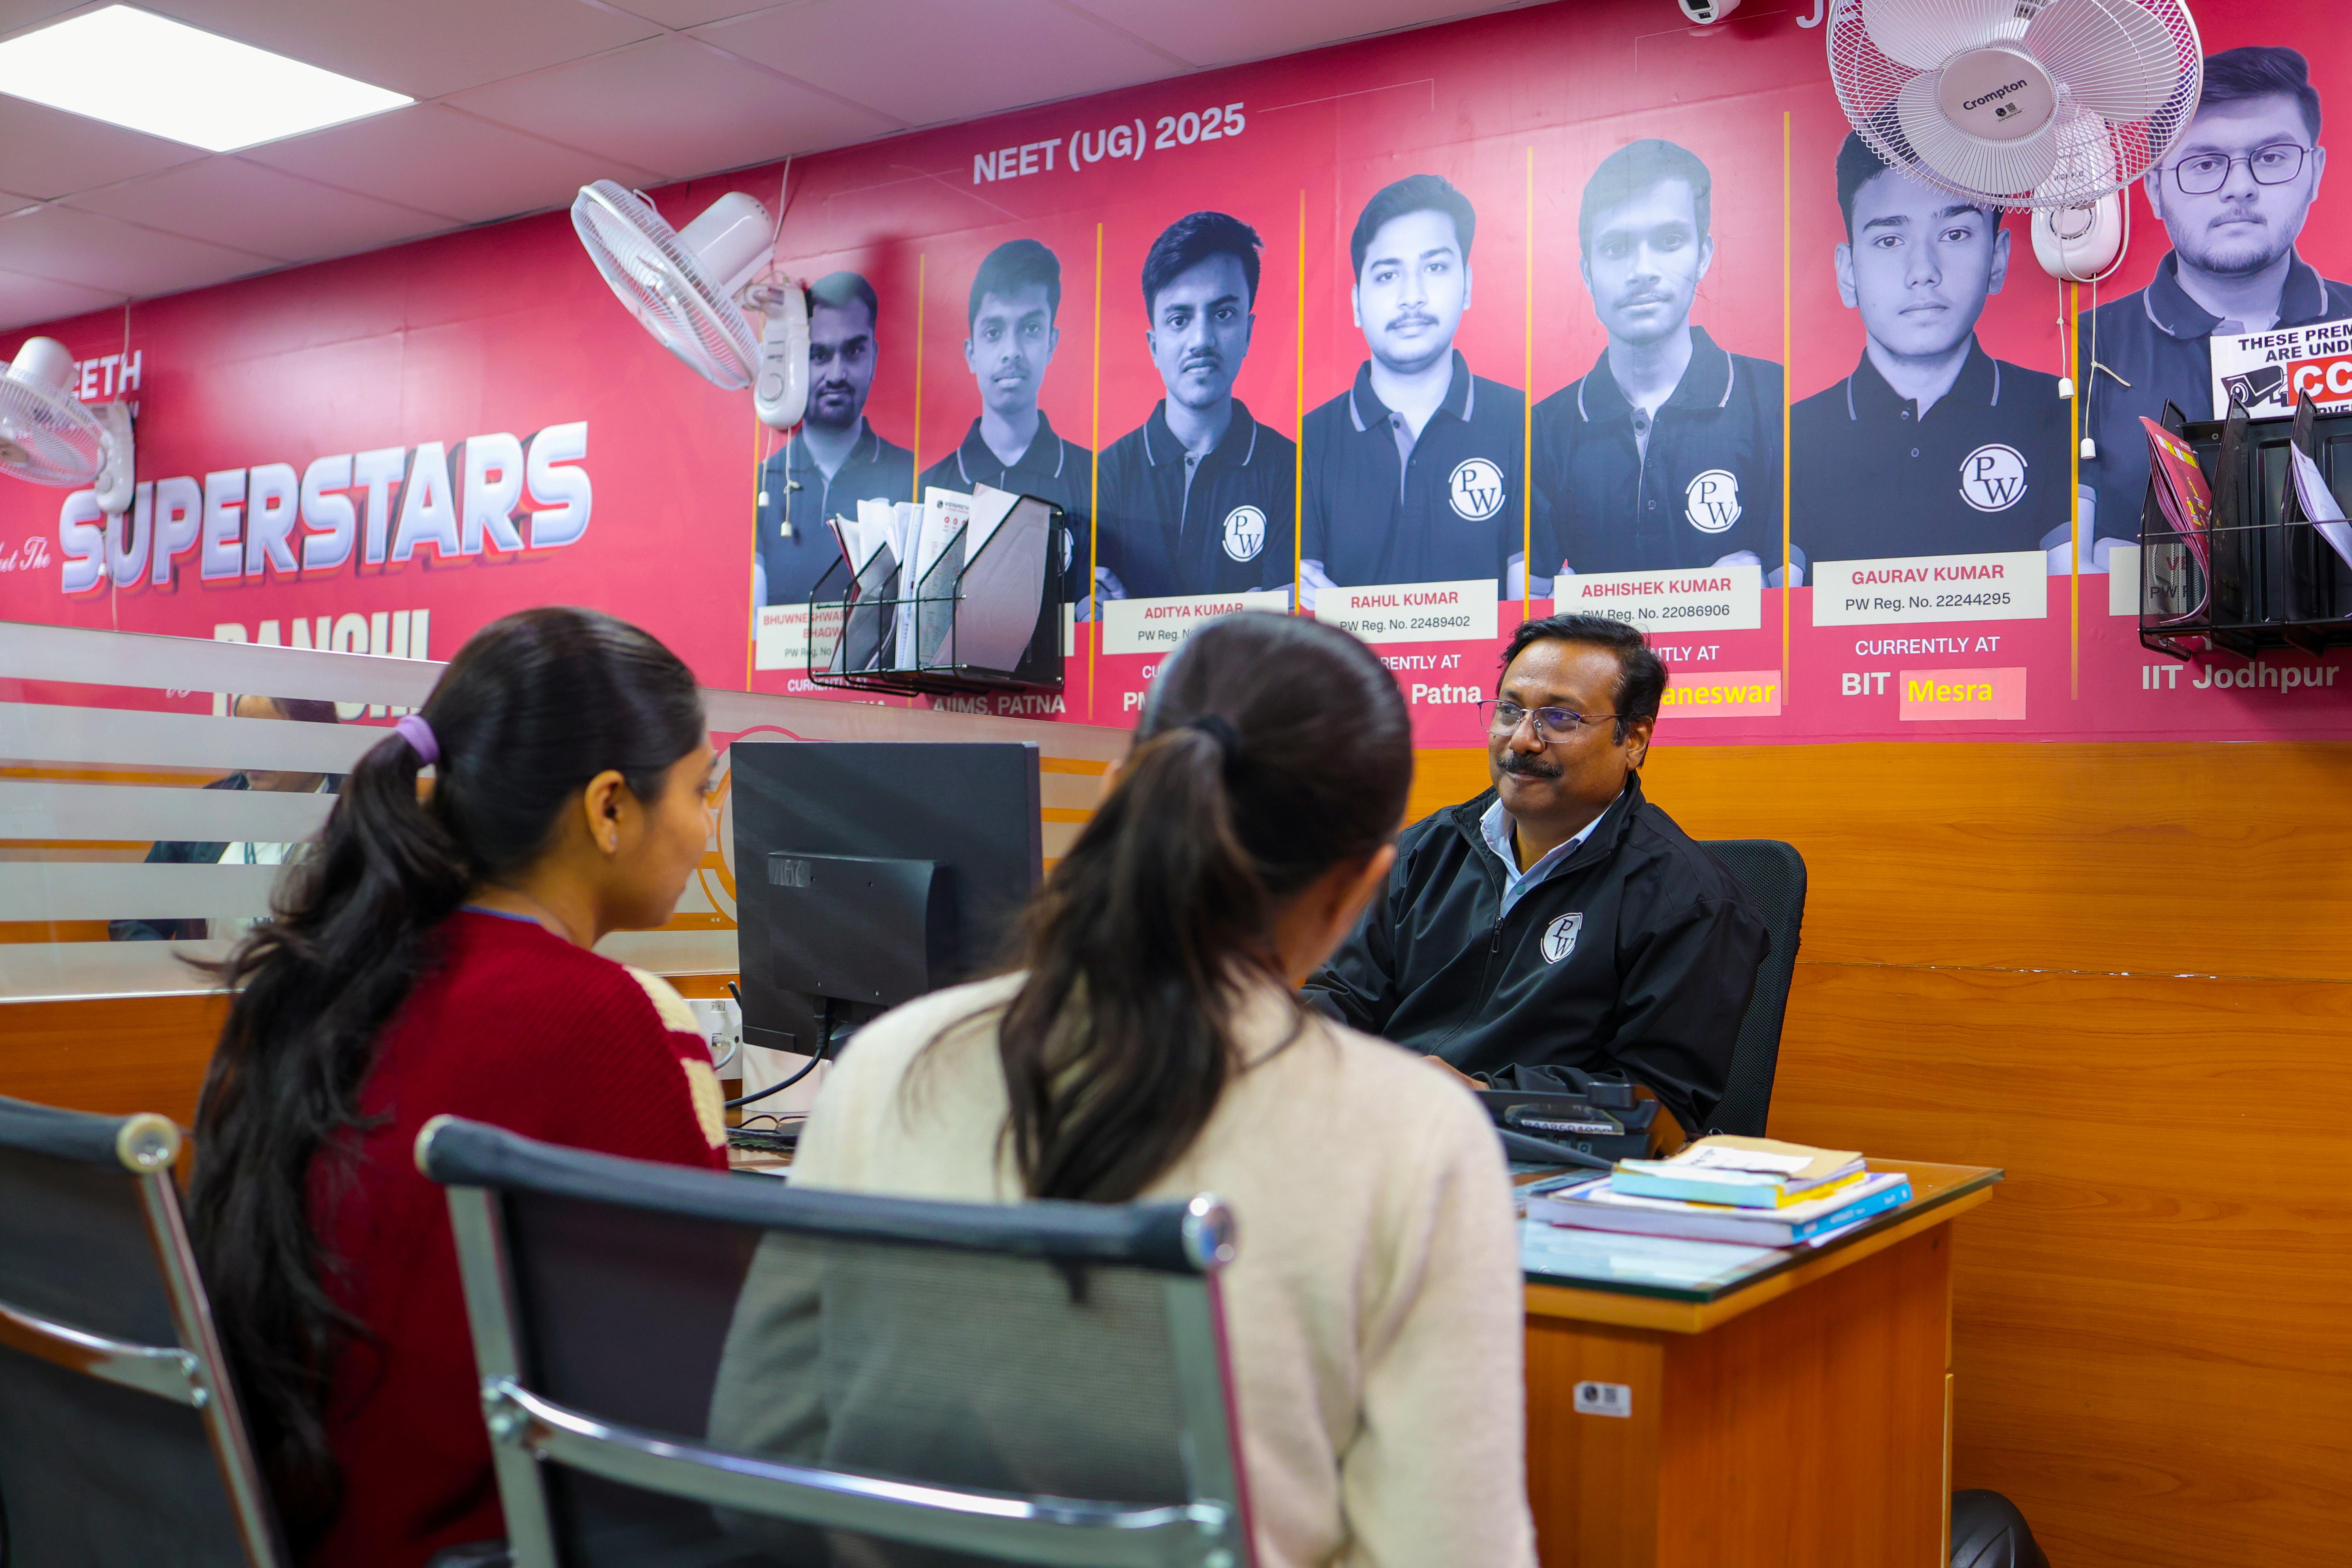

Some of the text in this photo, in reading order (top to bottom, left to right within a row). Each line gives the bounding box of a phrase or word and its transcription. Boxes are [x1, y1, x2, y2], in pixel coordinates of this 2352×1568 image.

[1963, 80, 2028, 110] Crompton
[974, 102, 1246, 184] NEET (UG) 2025
[2238, 332, 2299, 351] THESE
[2265, 346, 2302, 362] ARE
[59, 421, 593, 593] SUPERSTARS
[20, 536, 52, 571] The
[1852, 564, 2005, 585] GAURAV KUMAR
[1581, 578, 1732, 597] ABHISHEK KUMAR
[1351, 591, 1459, 608] RAHUL KUMAR
[1846, 592, 2011, 612] PW Reg. No. 22244295
[1144, 603, 1244, 619] ADITYA KUMAR
[1608, 610, 1635, 622] Reg.
[1639, 608, 1659, 619] No.
[1662, 604, 1730, 618] 22086906
[1340, 616, 1470, 633] PW Reg. No. 22489402
[1138, 631, 1156, 641] PW
[1158, 630, 1180, 642] Reg.
[1855, 636, 2001, 656] CURRENTLY AT
[785, 648, 798, 657] PW
[1441, 654, 1462, 668] AT
[1697, 645, 1720, 661] AT
[1842, 672, 1993, 702] BIT Mesra
[2143, 661, 2339, 693] IIT Jodhpur
[1412, 683, 1483, 704] Patna
[1662, 685, 1776, 705] aneswar
[933, 694, 1066, 716] AIIMS, PATNA
